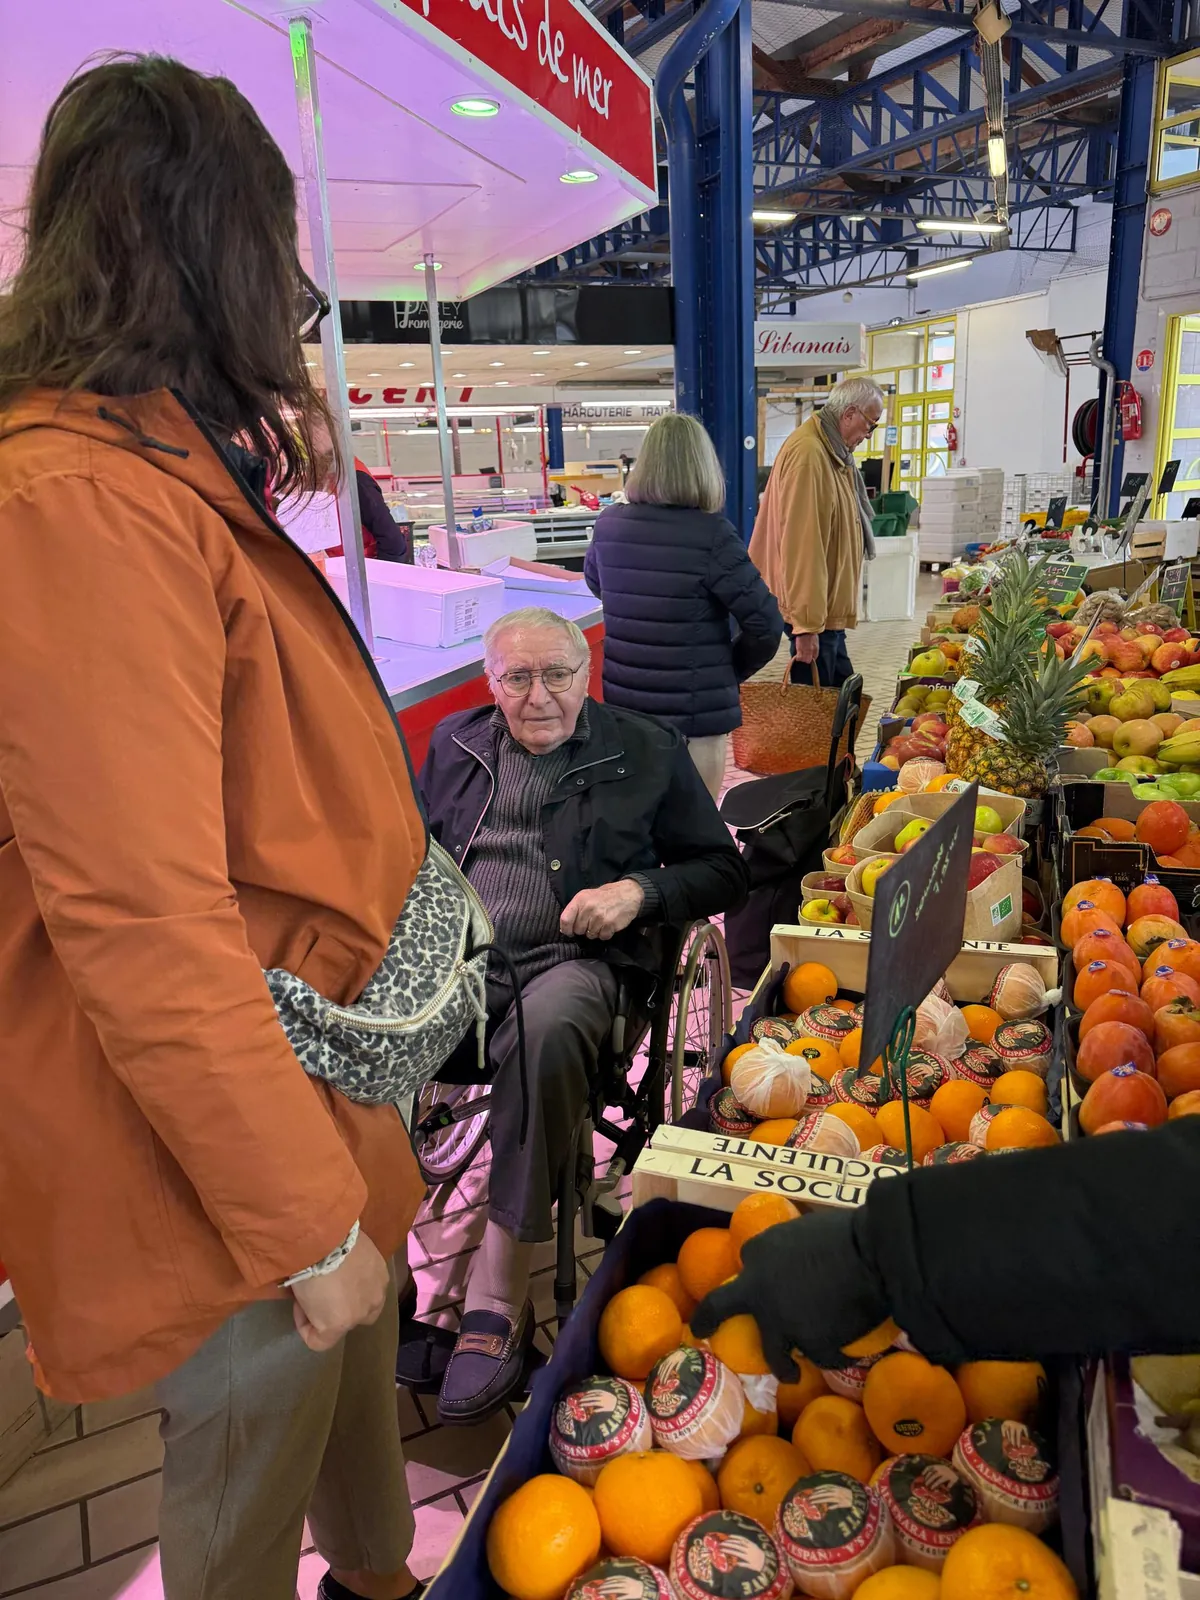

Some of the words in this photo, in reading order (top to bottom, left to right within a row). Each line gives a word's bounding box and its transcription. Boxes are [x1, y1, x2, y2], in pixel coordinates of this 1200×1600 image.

[537, 0, 568, 83] de
[573, 53, 612, 120] mer
[754, 330, 855, 354] Libanais
[561, 405, 632, 418] HARCUTERIE
[815, 928, 845, 938] LA
[690, 1157, 735, 1182] LA
[712, 1137, 902, 1179] OCULENTE
